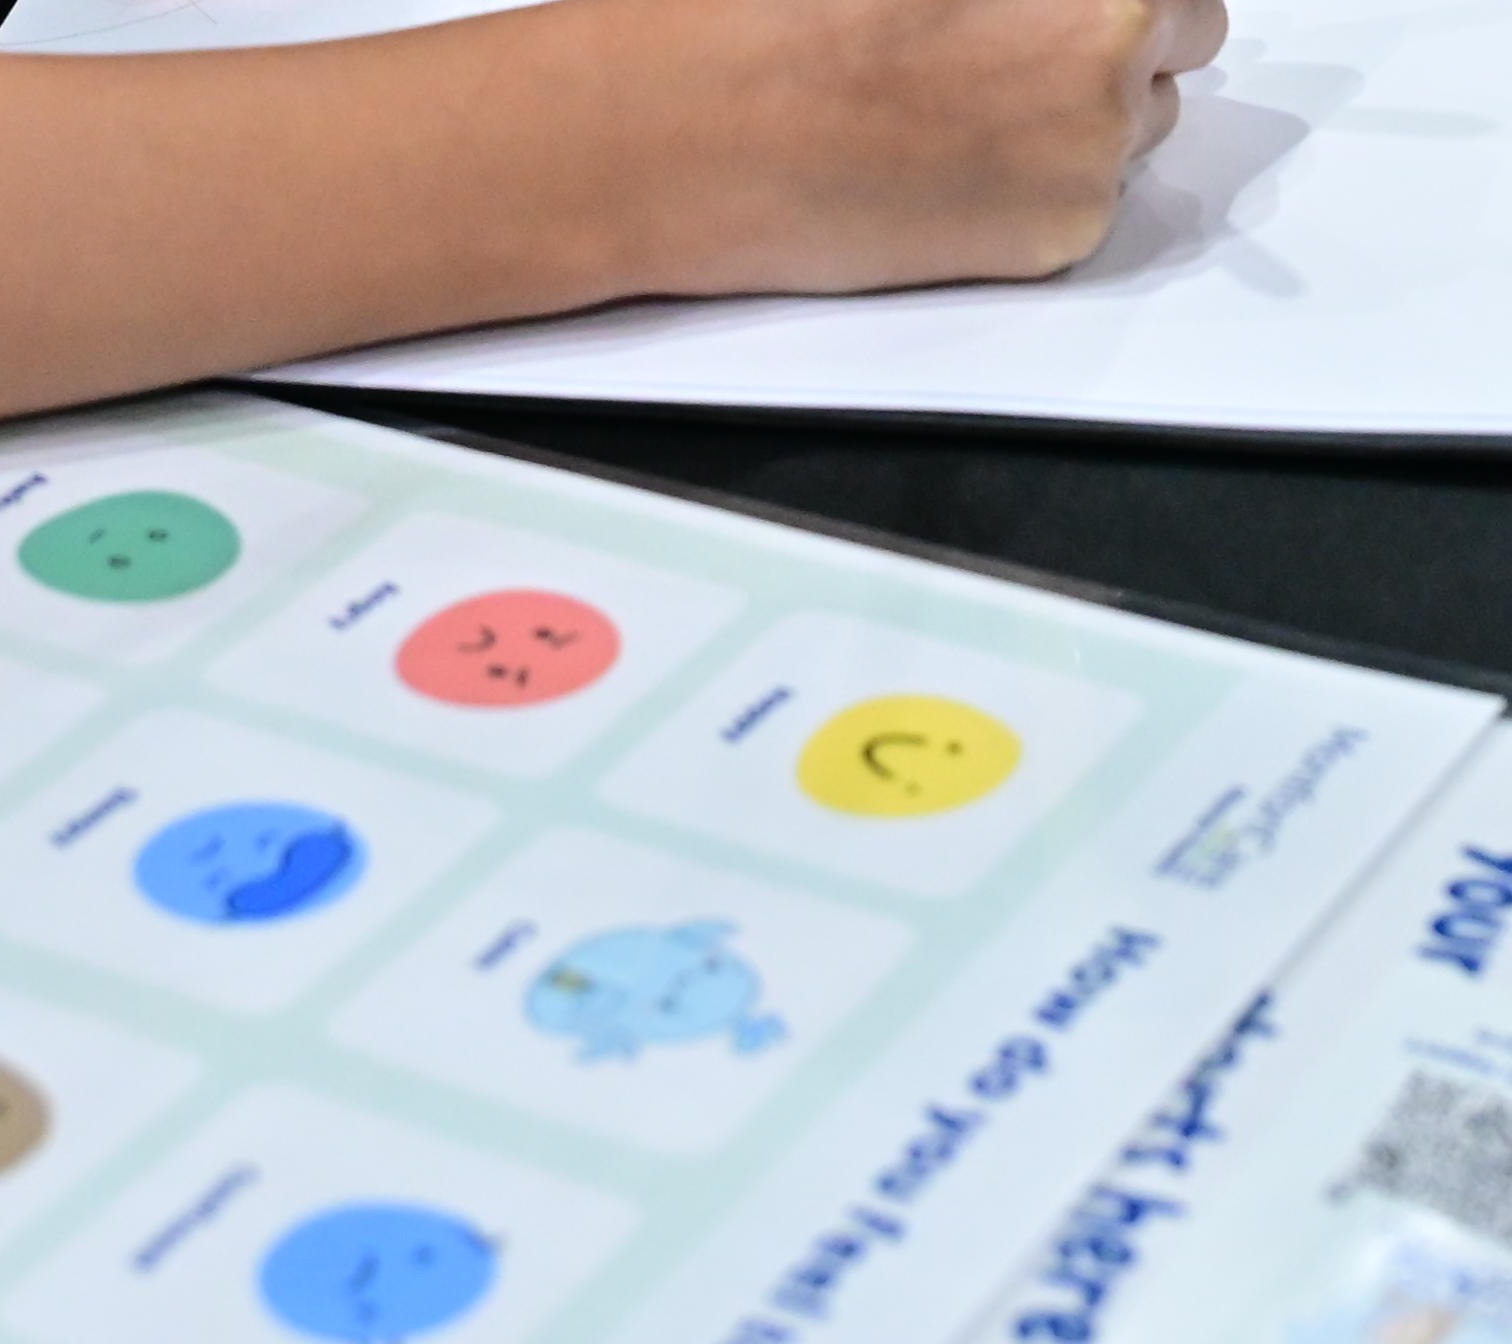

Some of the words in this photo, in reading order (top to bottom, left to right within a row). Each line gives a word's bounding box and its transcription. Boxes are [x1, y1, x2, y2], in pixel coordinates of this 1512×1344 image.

[1033, 923, 1163, 1032] How
[967, 1032, 1050, 1102] do
[874, 1102, 988, 1204] you
[1011, 1184, 1194, 1344] here
